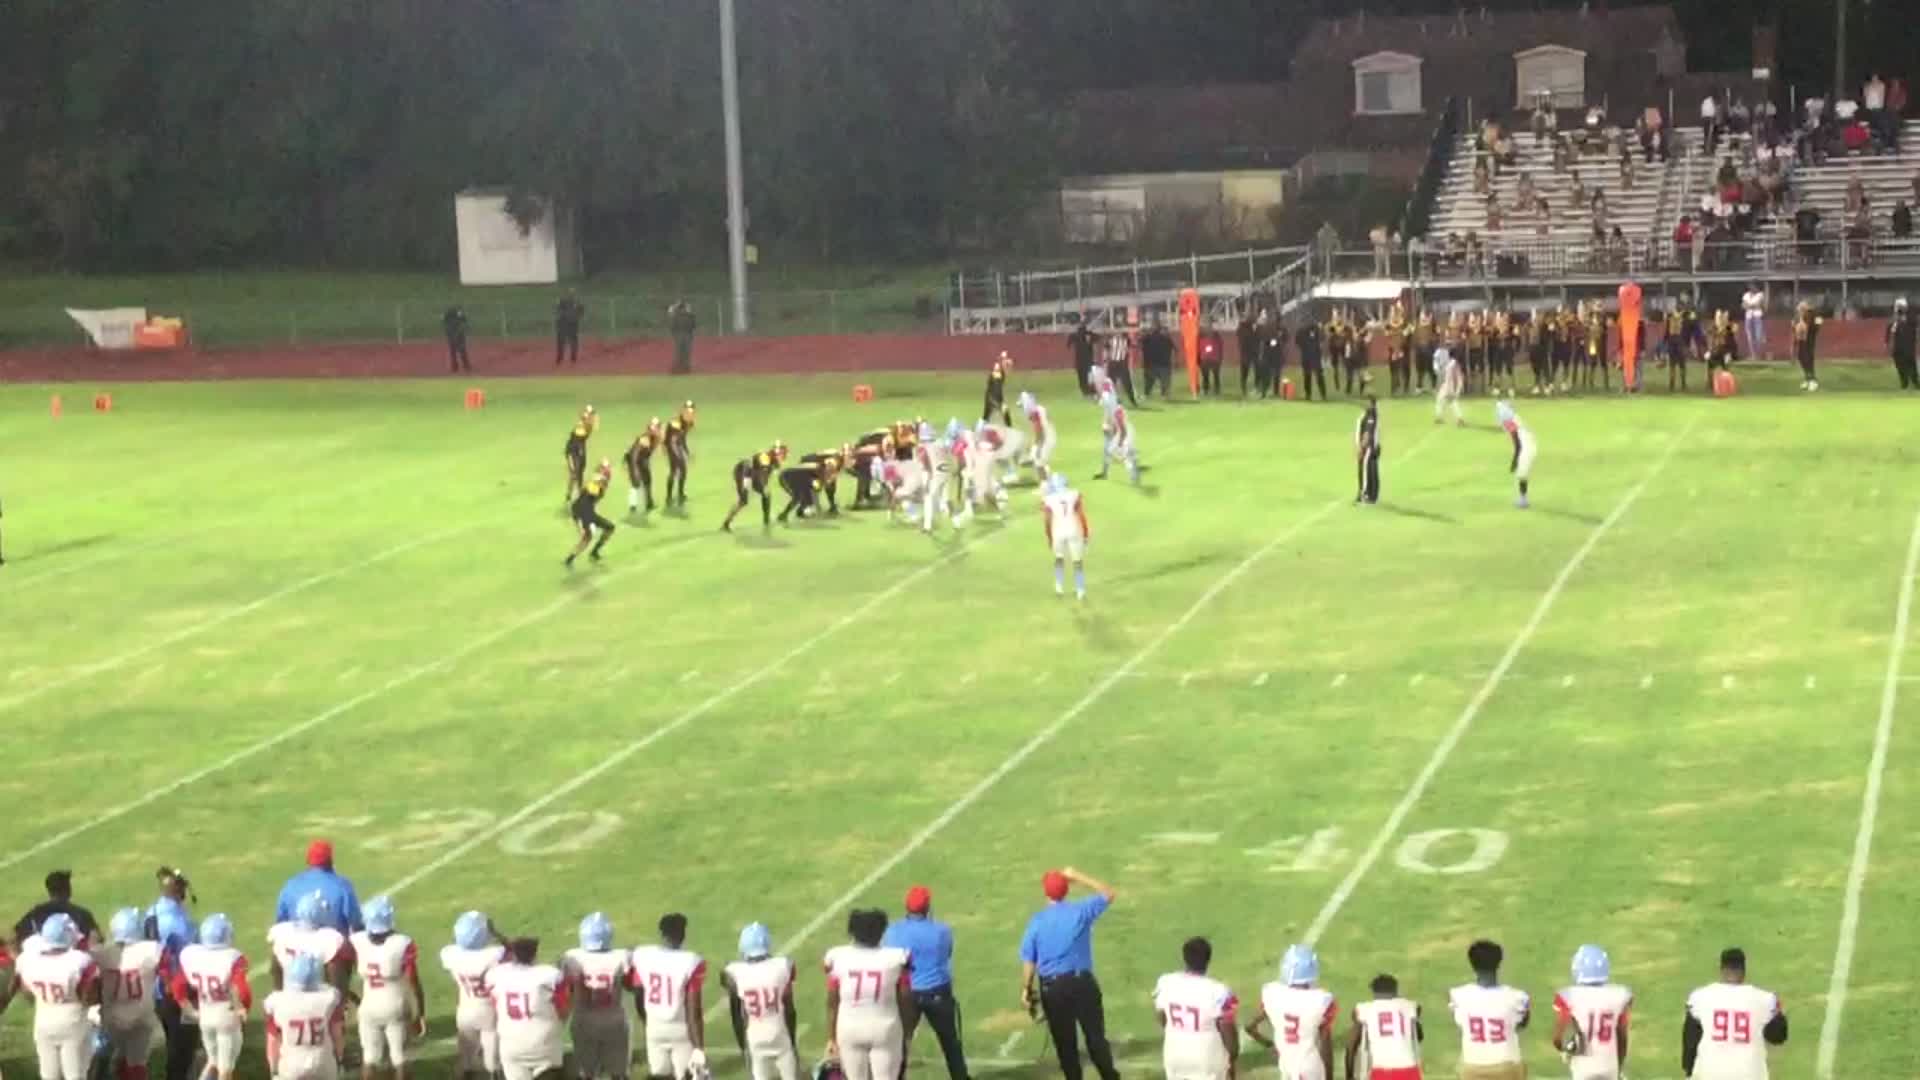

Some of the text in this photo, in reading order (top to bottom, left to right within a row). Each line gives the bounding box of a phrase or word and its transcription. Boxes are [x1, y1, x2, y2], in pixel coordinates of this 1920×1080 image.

[367, 963, 385, 988] 2
[848, 970, 882, 1003] 77
[1469, 1016, 1506, 1043] 93
[1588, 1012, 1614, 1042] 16
[1712, 1010, 1750, 1043] 99
